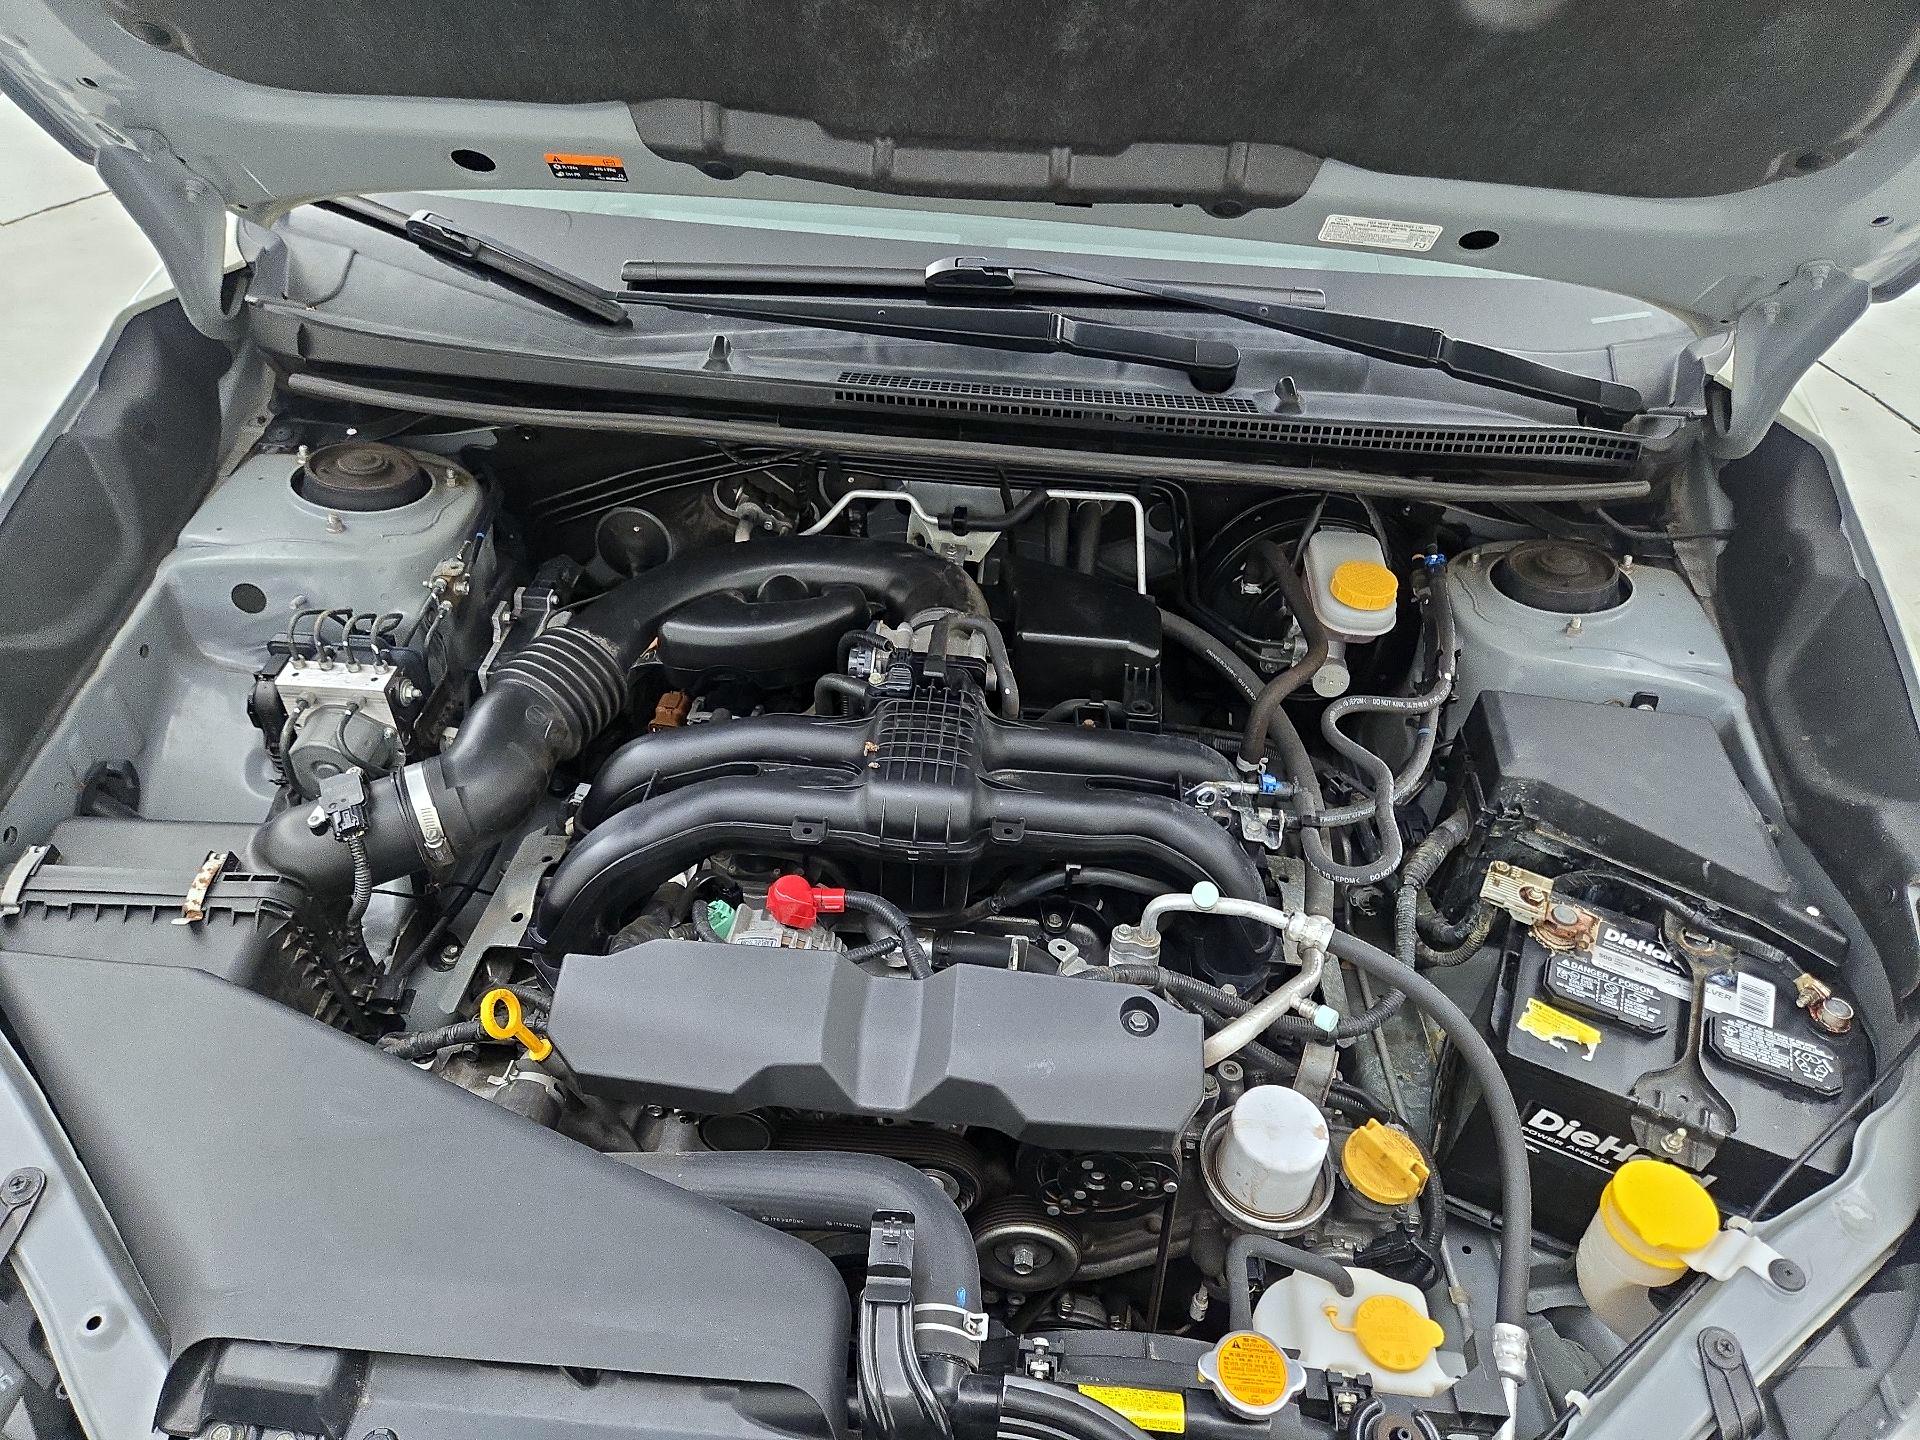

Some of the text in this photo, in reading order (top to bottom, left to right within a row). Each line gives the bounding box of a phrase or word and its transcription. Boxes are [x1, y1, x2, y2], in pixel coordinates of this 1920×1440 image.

[1604, 928, 1675, 964] DieHar
[1570, 960, 1609, 981] DANGER
[1618, 978, 1654, 996] POISON
[1522, 1126, 1610, 1166] POWER AHEAD
